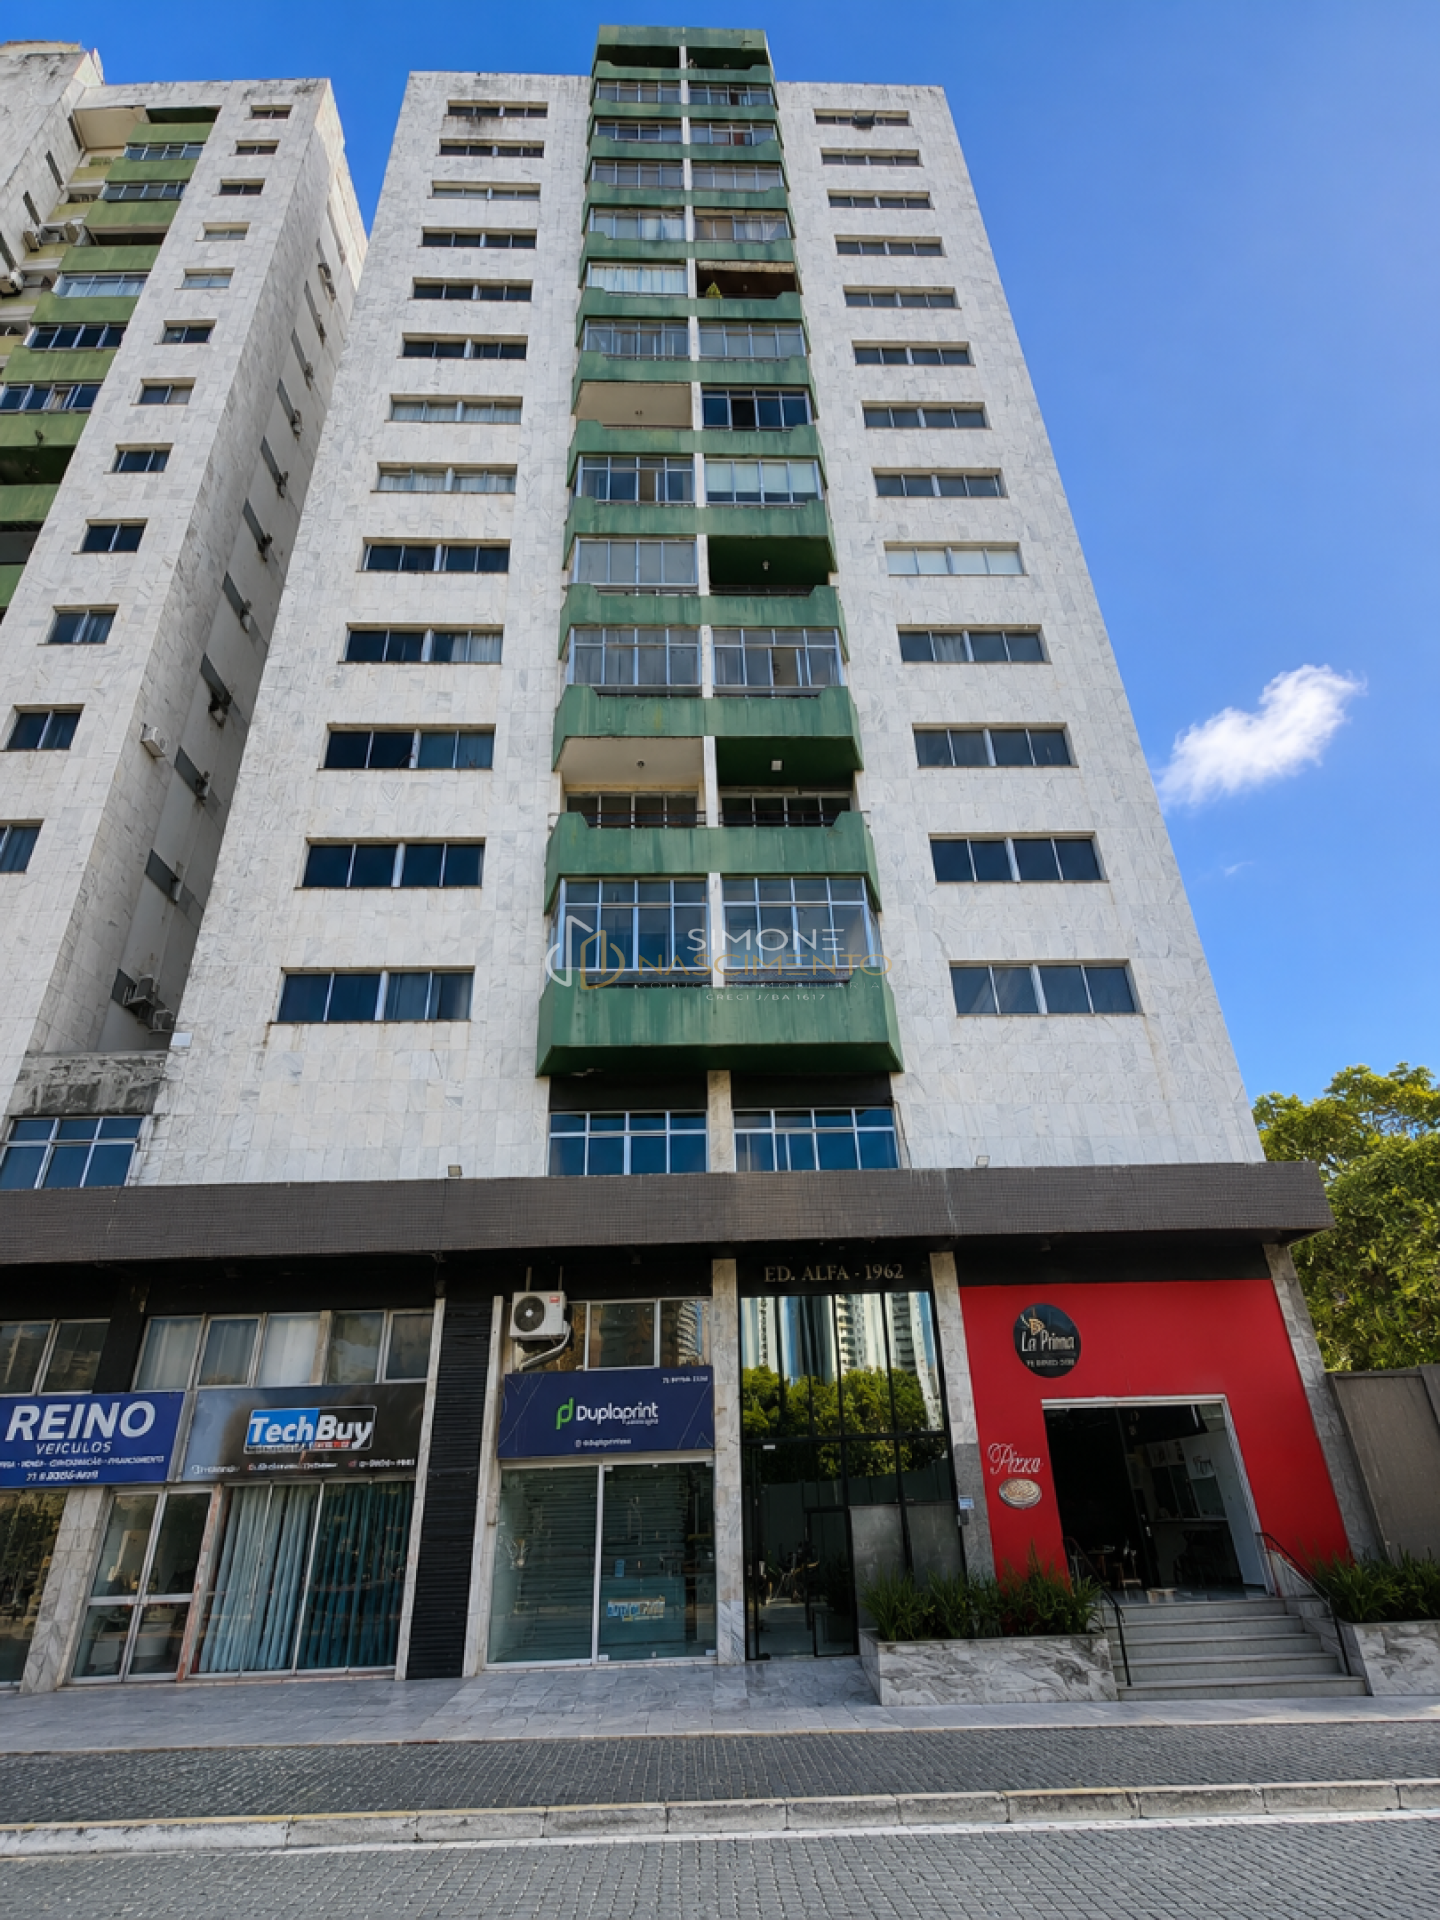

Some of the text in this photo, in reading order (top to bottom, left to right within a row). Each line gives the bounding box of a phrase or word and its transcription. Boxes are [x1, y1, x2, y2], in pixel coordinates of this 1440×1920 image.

[764, 1265, 796, 1282] ED.
[801, 1264, 850, 1281] ALFA
[864, 1263, 904, 1279] 1962
[1021, 1331, 1037, 1352] La
[4, 1400, 156, 1441] REINO
[575, 1401, 659, 1425] Duplaprint
[250, 1414, 373, 1449] TechBuy
[987, 1443, 1043, 1475] Pizza
